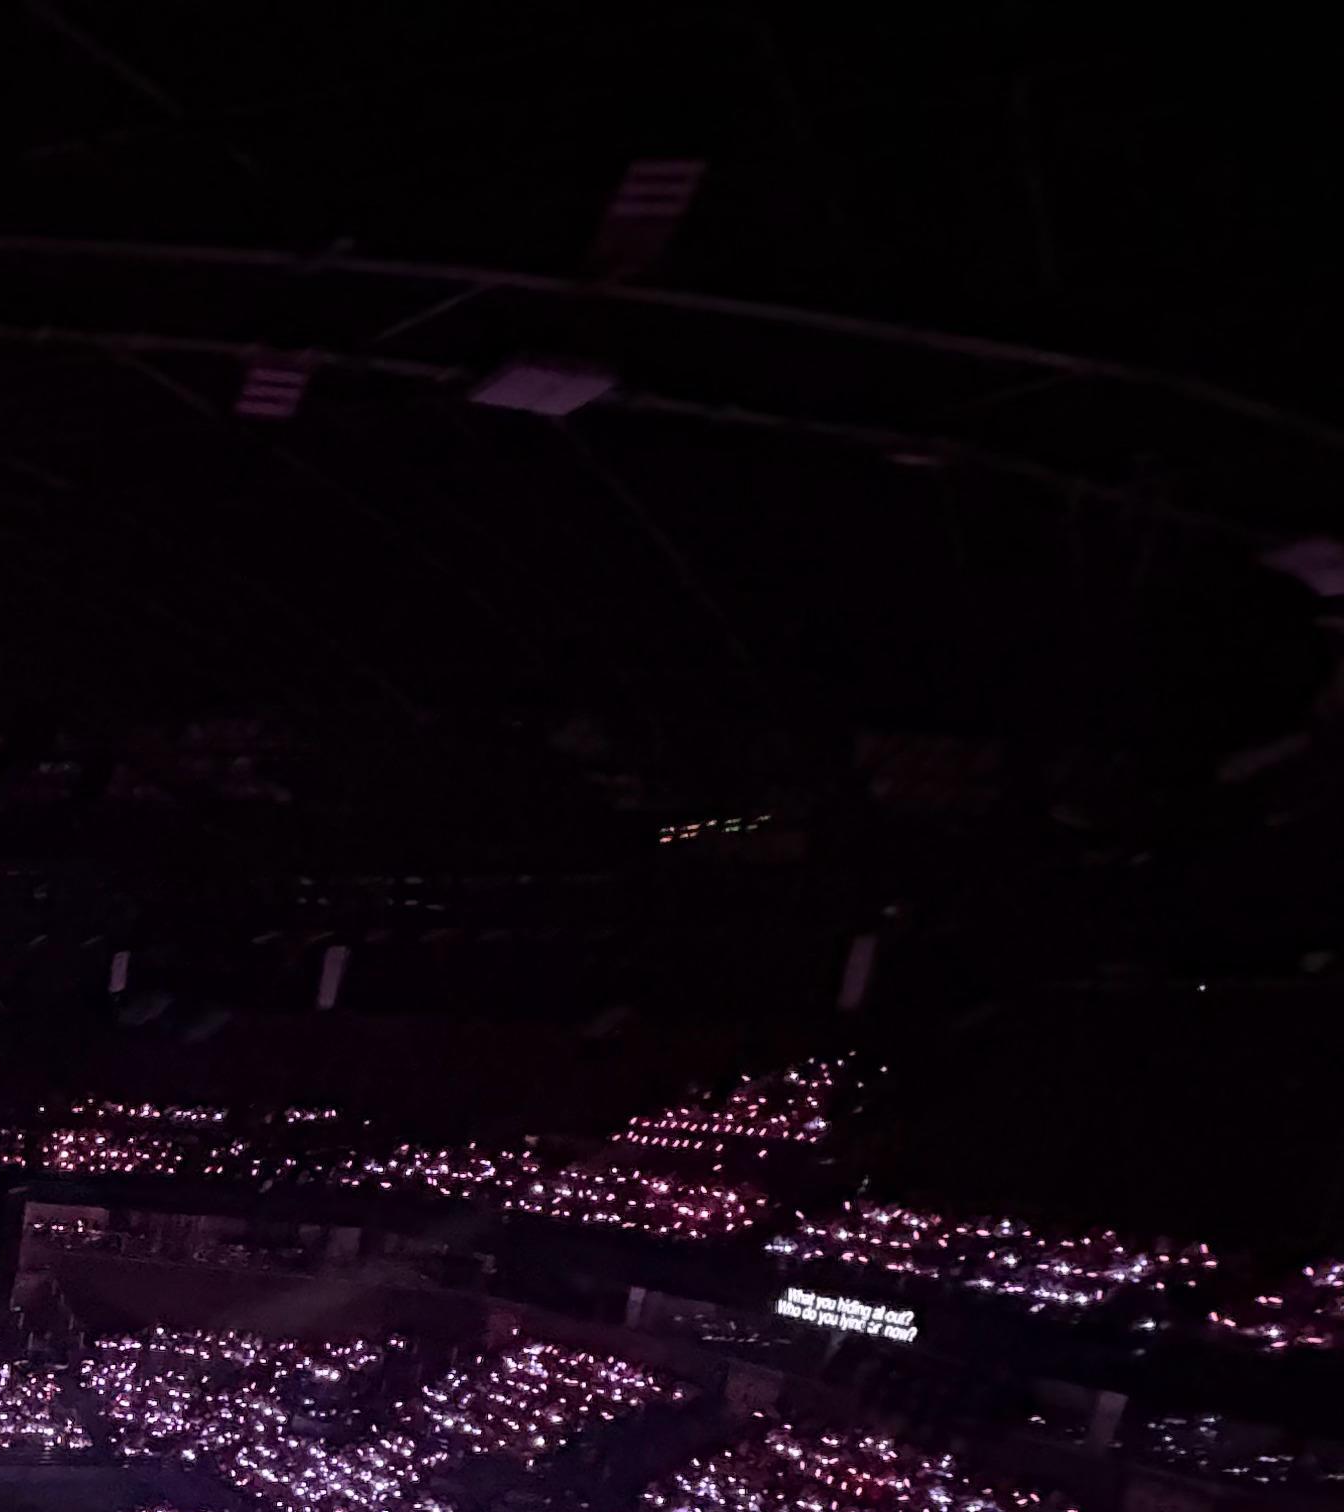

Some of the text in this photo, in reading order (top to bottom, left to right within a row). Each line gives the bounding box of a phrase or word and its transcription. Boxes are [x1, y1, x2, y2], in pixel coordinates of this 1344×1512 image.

[777, 1299, 802, 1318] Who
[802, 1306, 817, 1321] do
[818, 1311, 839, 1326] you
[884, 1325, 918, 1342] now?
[787, 1287, 816, 1306] What
[816, 1296, 837, 1312] you
[837, 1297, 872, 1320] hiding
